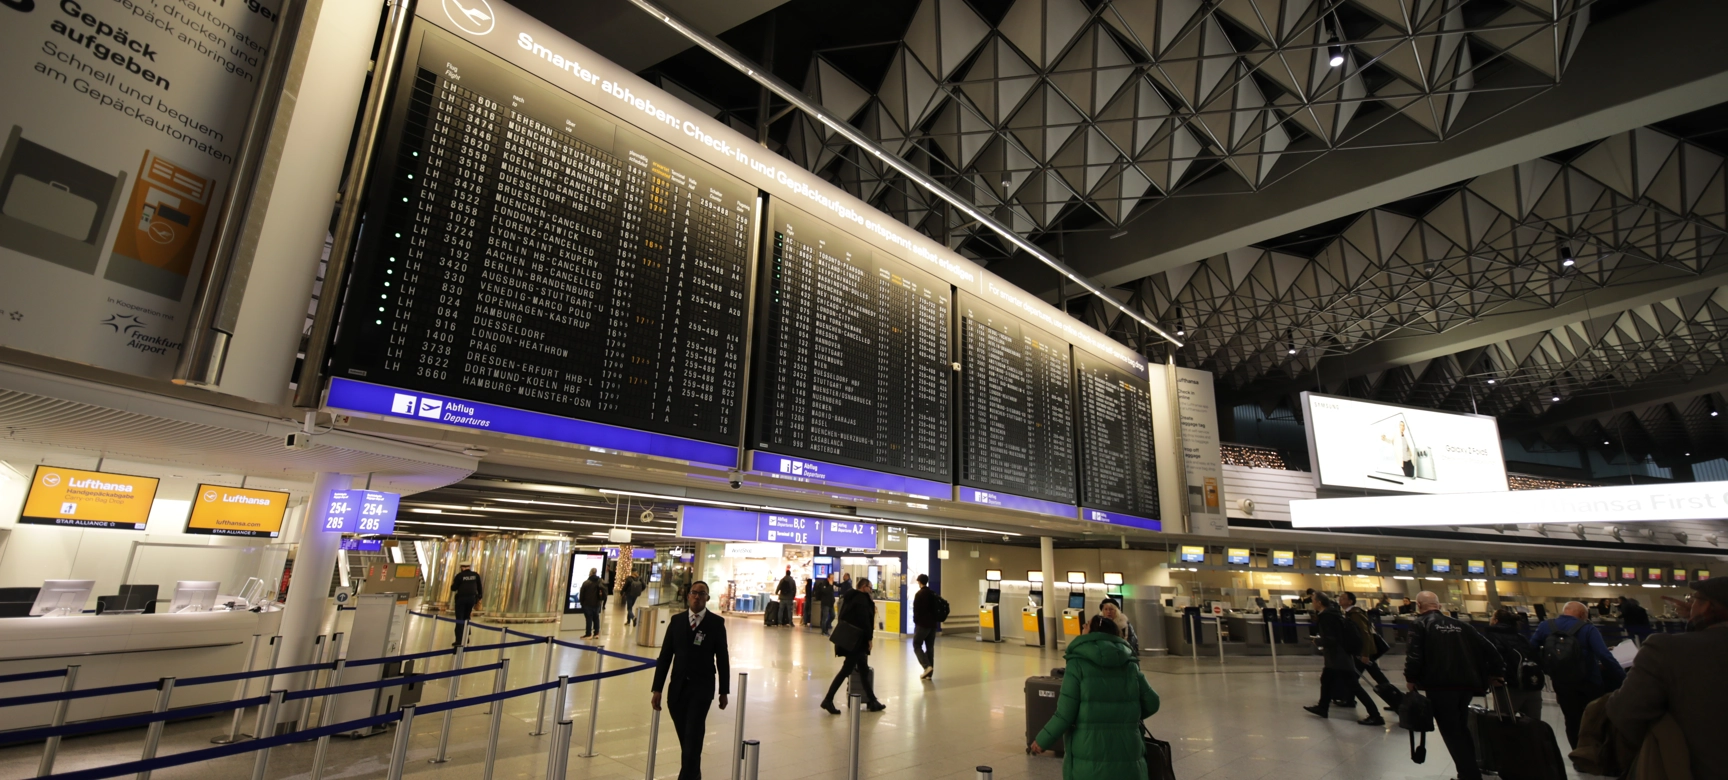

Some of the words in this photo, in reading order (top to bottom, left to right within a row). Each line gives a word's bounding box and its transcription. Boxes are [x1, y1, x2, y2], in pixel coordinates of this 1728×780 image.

[58, 0, 158, 62] Gepäck
[163, 4, 226, 48] drucken
[230, 46, 258, 68] und
[50, 19, 170, 90] aufgeben
[178, 32, 253, 82] anbringen
[446, 62, 458, 72] Flug
[42, 40, 114, 86] Schnell
[118, 82, 153, 106] und
[156, 99, 224, 142] bequem
[445, 70, 460, 80] Flight
[34, 61, 68, 84] am
[73, 78, 232, 164] Gepäckautomaten
[443, 80, 457, 93] LH
[478, 96, 497, 111] 600
[510, 111, 552, 136] TEHERAN
[440, 90, 455, 104] LH
[469, 103, 496, 121] 3416
[508, 121, 621, 177] MUENCHEN-STUTTGART-U
[467, 113, 494, 132] 3474
[506, 131, 620, 187] MUENCHEN-WUERZBURG-N
[518, 32, 600, 86] Smarter
[601, 79, 680, 130] abheben:
[683, 121, 749, 167] Check-in
[750, 159, 776, 178] und
[777, 170, 864, 226] Gepäckaufgabe
[865, 220, 912, 251] entspannt
[912, 244, 938, 264] selbst
[456, 166, 484, 184] 1016
[497, 182, 547, 208] BRUESSEL
[459, 155, 486, 173] 3518
[499, 172, 566, 205] DUESSELDORF
[572, 200, 588, 214] HBF
[461, 145, 488, 163] 3558
[501, 162, 606, 210] MUENCHEN-CANCELLED
[463, 134, 490, 152] 3620
[503, 151, 534, 170] KOELN
[540, 167, 613, 203] HBF-CANCELLED
[452, 188, 480, 206] 1522
[454, 177, 482, 195] 3476
[495, 193, 602, 239] MUENCHEN-CANCELLED
[420, 189, 436, 202] EN
[450, 199, 478, 216] 8858
[492, 214, 594, 257] FLORENZ-CANCELLED
[448, 211, 476, 228] 1078
[490, 225, 552, 253] LYON-SAINT
[559, 249, 598, 269] EXUPERY
[443, 233, 472, 250] 3540
[486, 247, 525, 267] AACHEN
[531, 262, 601, 291] HB-CANCELLED
[445, 222, 474, 239] 3724
[488, 236, 526, 256] BERLIN
[533, 251, 602, 281] HB-CANCELLED
[439, 256, 468, 273] 3420
[482, 269, 604, 313] AUGSBURG-STUTTGART-U
[448, 247, 470, 262] 192
[484, 258, 594, 299] BERLIN-BRANDENBURG
[988, 282, 1000, 296] For
[116, 298, 162, 318] Kooperation
[439, 294, 461, 308] 024
[476, 304, 522, 324] HAMBURG
[441, 282, 463, 296] 830
[478, 292, 590, 330] KOPENHAGEN-KASTRUP
[444, 270, 466, 284] 330
[480, 281, 562, 312] VENEDIG-MARCO
[569, 306, 591, 320] POLO
[131, 330, 182, 350] Frankfurt
[424, 328, 455, 344] 1400
[469, 339, 497, 353] PRAG
[434, 318, 457, 332] 916
[471, 327, 568, 358] LONDON-HEATHROW
[437, 306, 459, 320] 084
[473, 315, 546, 341] DUESSELDORF
[126, 339, 166, 356] Airport
[422, 341, 452, 356] 3738
[467, 351, 559, 379] DRESDEN-ERFURT
[565, 373, 594, 387] HHB-L
[384, 360, 402, 372] LH
[417, 366, 448, 381] 3660
[463, 375, 592, 408] HAMBURG-MUENSTER-OSN
[419, 354, 450, 368] 3622
[465, 363, 558, 390] DORTMUND-KOELN
[564, 384, 581, 395] HBF
[444, 412, 490, 428] Departures
[446, 402, 474, 415] Abflug
[1314, 402, 1340, 410] SAMSUNG
[68, 477, 133, 492] Lufthansa
[804, 462, 818, 472] Abflug
[804, 470, 826, 480] Departures
[66, 488, 134, 500] Handgepäckabgabe
[222, 494, 270, 506] Lufthansa
[330, 502, 352, 514] 254-
[362, 503, 388, 516] 254-
[1650, 494, 1716, 510] First
[326, 517, 344, 528] 285
[360, 518, 380, 530] 285
[794, 518, 806, 529] B,C
[795, 532, 808, 543] D,E
[852, 524, 863, 534] A,Z
